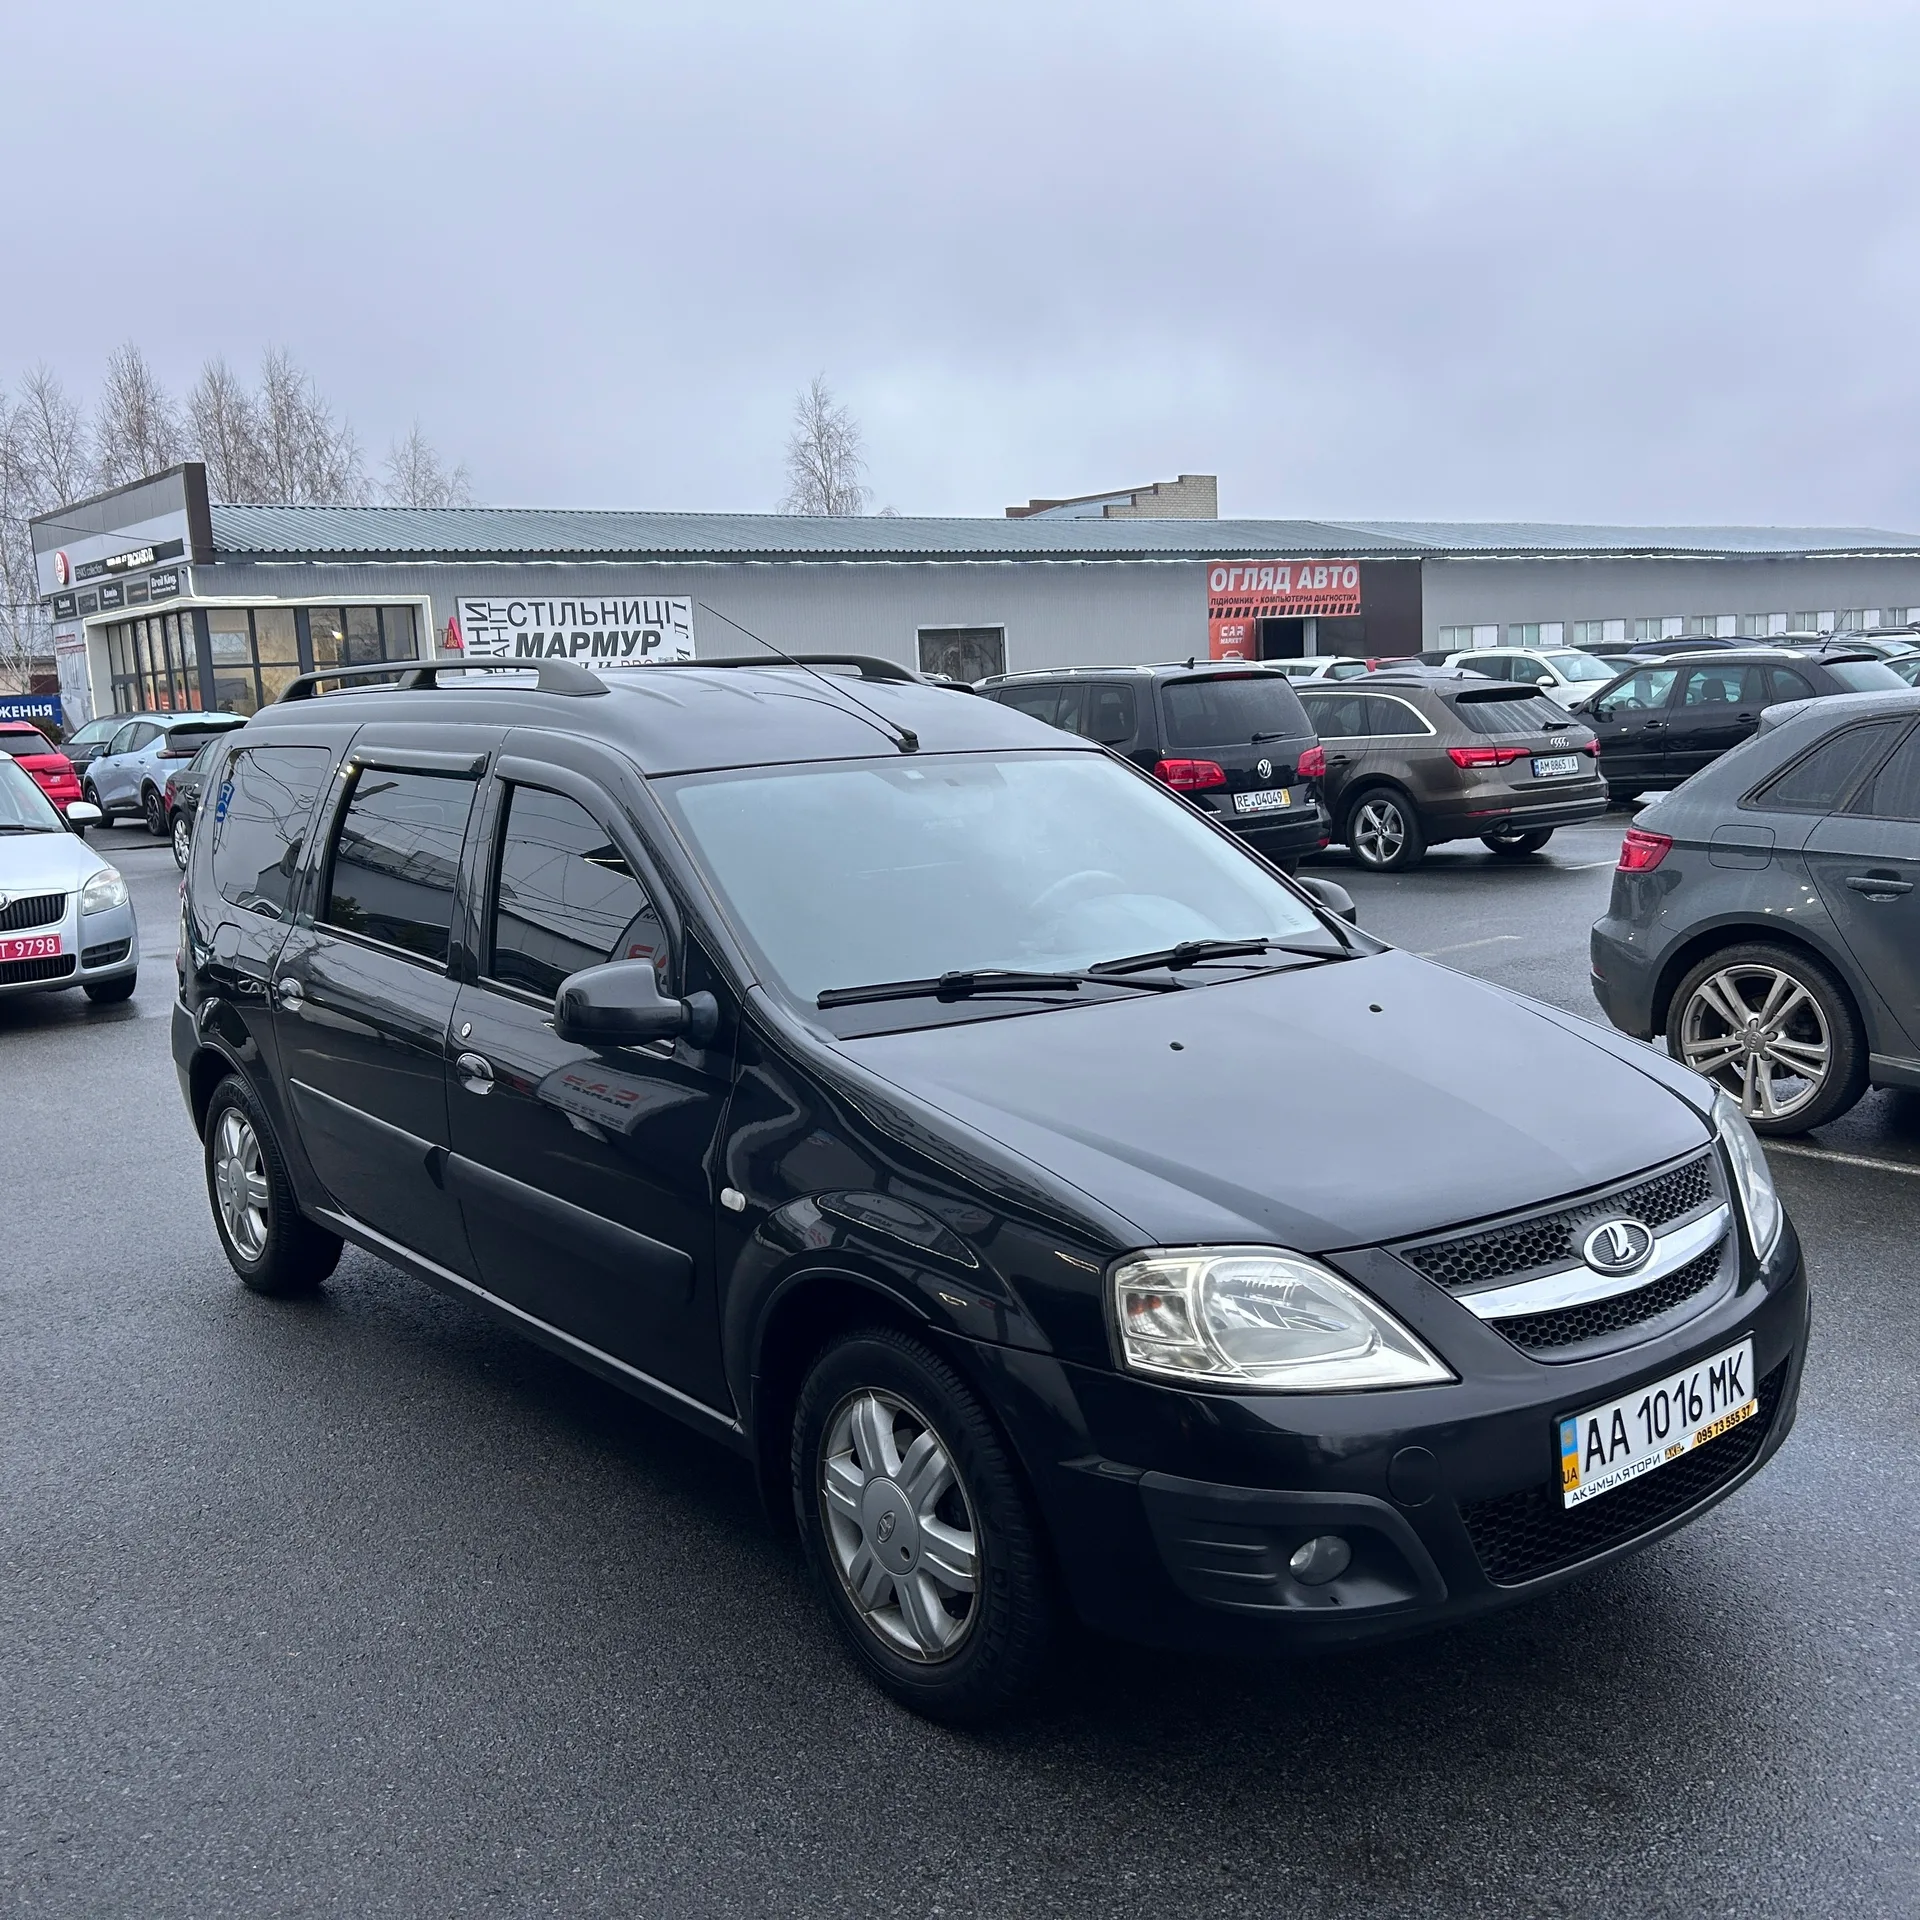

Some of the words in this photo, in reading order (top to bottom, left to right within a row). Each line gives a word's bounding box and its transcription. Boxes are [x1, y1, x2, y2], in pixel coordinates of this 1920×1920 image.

[1210, 567, 1291, 594] ОГЛЯД
[1297, 566, 1358, 590] АВТО
[1211, 597, 1254, 606] ПІДЙОМНИК
[507, 601, 671, 629] СТІЛЬНИЦІ
[1221, 625, 1244, 637] CAR
[515, 630, 661, 658] МАРМУР
[1220, 637, 1243, 645] MARKET
[0, 704, 53, 718] ЖЕННЯ
[1540, 760, 1550, 771] AM
[15, 938, 56, 957] 9798
[1585, 1408, 1631, 1473] AA
[1637, 1372, 1703, 1444] 1016
[1708, 1351, 1745, 1414] MK
[1572, 1453, 1661, 1504] АКУМУЛЯТОРИ
[1697, 1427, 1713, 1444] 095
[1714, 1420, 1725, 1434] 73
[1726, 1411, 1741, 1428] 555
[1742, 1404, 1751, 1419] 37
[1563, 1467, 1578, 1485] UA
